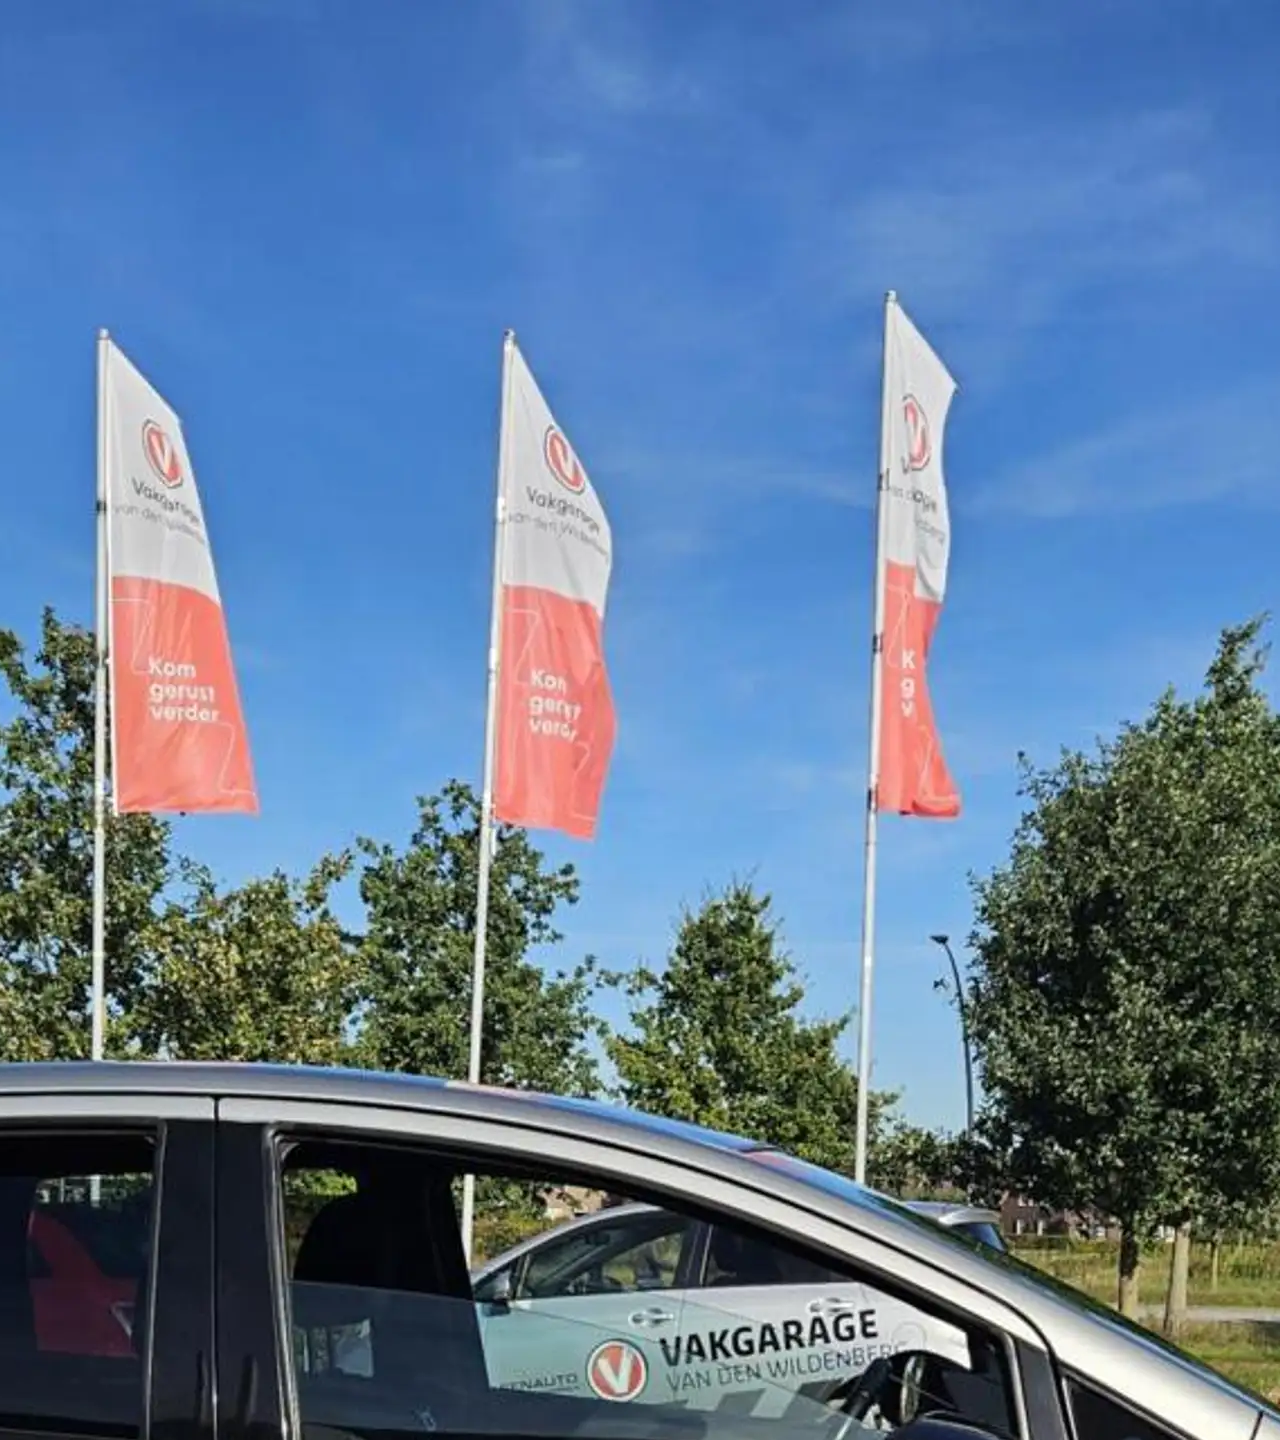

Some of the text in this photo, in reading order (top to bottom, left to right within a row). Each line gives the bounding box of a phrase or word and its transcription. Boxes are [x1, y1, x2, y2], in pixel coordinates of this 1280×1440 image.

[148, 656, 197, 679] Kom
[149, 701, 220, 722] verder
[660, 1309, 879, 1367] VAKGARAGE
[666, 1370, 712, 1392] VAN
[716, 1363, 762, 1386] DEN
